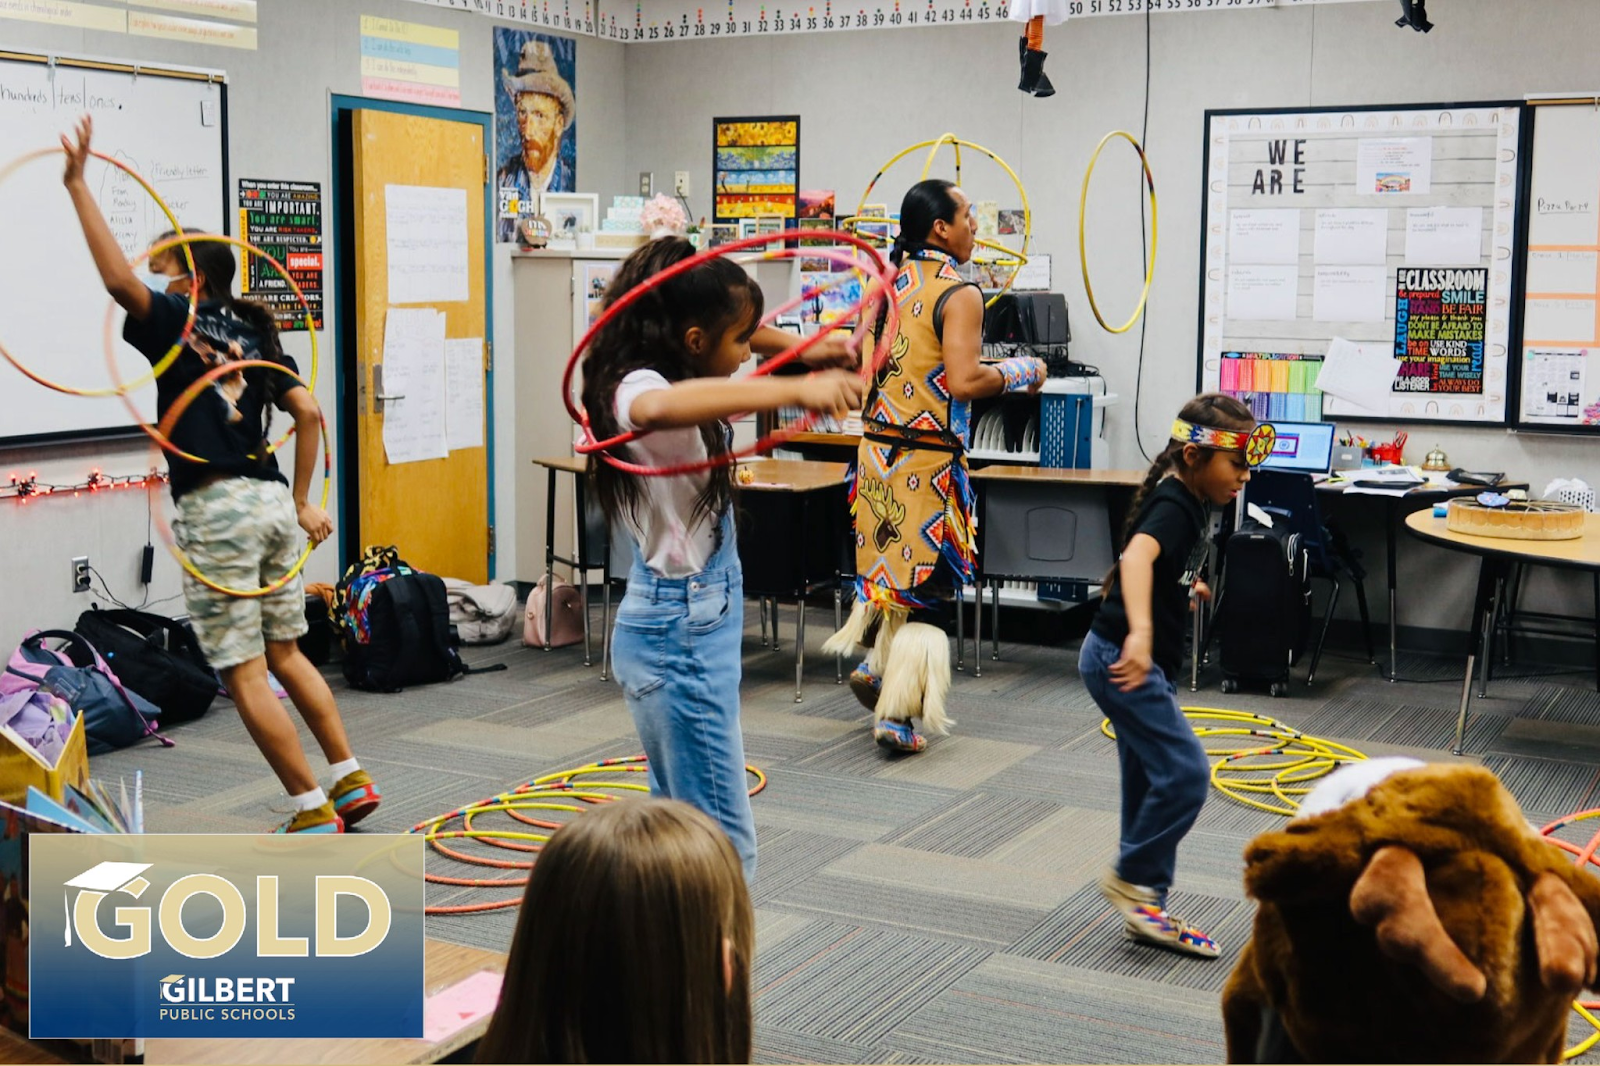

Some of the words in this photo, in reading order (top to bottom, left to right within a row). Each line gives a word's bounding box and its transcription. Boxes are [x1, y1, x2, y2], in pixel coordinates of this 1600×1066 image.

[1070, 2, 1082, 14] 50
[1091, 1, 1101, 12] 51
[1108, 0, 1122, 11] 52
[1128, 0, 1141, 10] 53
[497, 5, 503, 15] 12
[509, 7, 515, 17] 13
[520, 9, 526, 19] 14
[532, 11, 538, 22] 15
[543, 13, 549, 24] 16
[554, 15, 560, 26] 17
[564, 17, 571, 28] 18
[575, 19, 581, 30] 19
[585, 21, 593, 32] 20
[600, 24, 606, 35] 21
[610, 26, 617, 38] 22
[620, 28, 628, 39] 23
[634, 28, 644, 39] 24
[649, 27, 658, 38] 25
[664, 26, 674, 37] 26
[680, 25, 689, 36] 27
[695, 24, 705, 36] 28
[710, 23, 720, 35] 29
[726, 22, 736, 33] 30
[742, 22, 750, 32] 31
[758, 21, 768, 32] 32
[774, 20, 784, 31] 33
[790, 19, 800, 30] 34
[807, 17, 817, 29] 35
[823, 16, 834, 28] 36
[840, 16, 850, 28] 37
[856, 15, 868, 27] 38
[873, 14, 884, 25] 39
[890, 13, 901, 24] 40
[908, 12, 917, 23] 41
[925, 11, 936, 22] 42
[942, 10, 954, 21] 43
[960, 8, 972, 20] 44
[978, 8, 990, 19] 45
[996, 6, 1008, 18] 46
[1269, 140, 1306, 165] WE
[280, 182, 289, 190] this
[1252, 168, 1306, 195] ARE
[265, 201, 320, 215] IMPORTANT.
[500, 200, 535, 213] GOGH
[1538, 197, 1561, 212] Pizza
[250, 211, 266, 224] You
[270, 215, 285, 224] are
[290, 215, 319, 225] smart.
[290, 256, 320, 268] special.
[265, 280, 287, 288] FRIEND.
[1406, 269, 1485, 290] CLASSROOM
[1409, 290, 1440, 300] prepared
[1442, 290, 1485, 304] SMILE
[1410, 304, 1440, 314] HAND
[1442, 304, 1457, 313] BE
[1459, 304, 1483, 314] FAIR
[1396, 298, 1408, 355] LAUGH
[1431, 322, 1439, 330] BE
[1442, 322, 1470, 330] AFRAID
[1473, 322, 1482, 330] TO
[1408, 330, 1435, 340] MAKE
[1437, 330, 1482, 340] MISTAKES
[1408, 339, 1417, 347] be
[1430, 348, 1467, 356] WORDS
[1428, 355, 1470, 365] imagination
[1397, 363, 1430, 376] HARE
[1395, 380, 1430, 391] LISTENER
